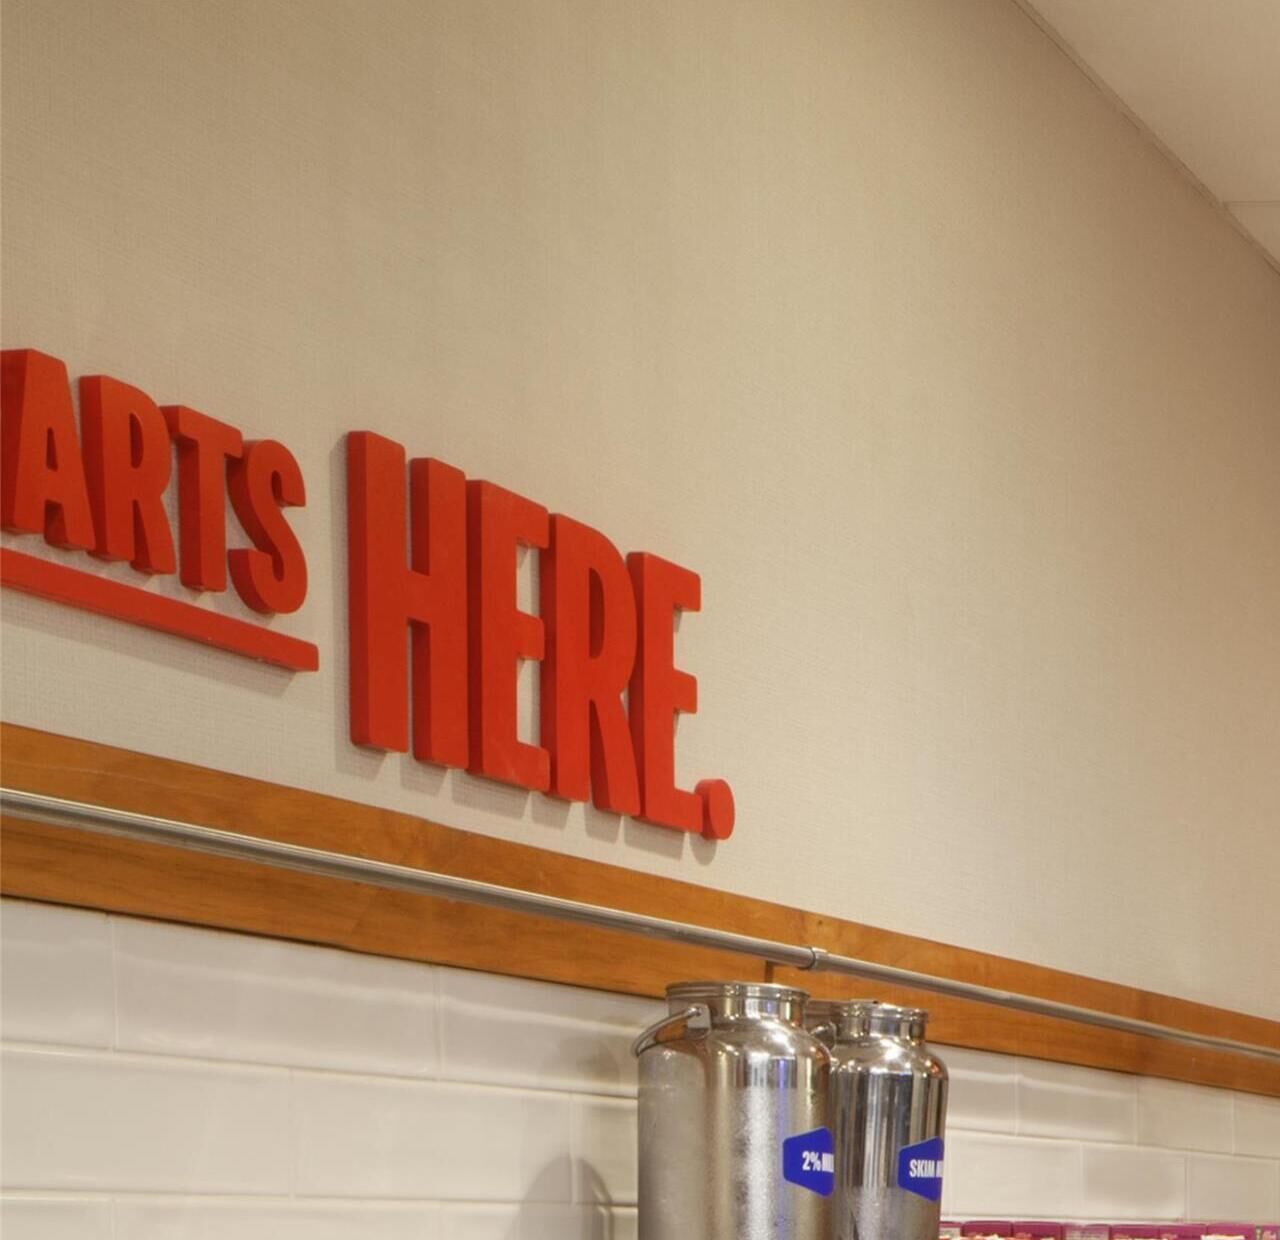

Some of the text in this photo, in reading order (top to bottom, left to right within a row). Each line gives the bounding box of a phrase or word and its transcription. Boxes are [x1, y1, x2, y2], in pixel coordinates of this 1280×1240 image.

[347, 430, 735, 840] HERE.
[802, 1150, 821, 1171] 2%
[909, 1159, 935, 1178] SKIM
